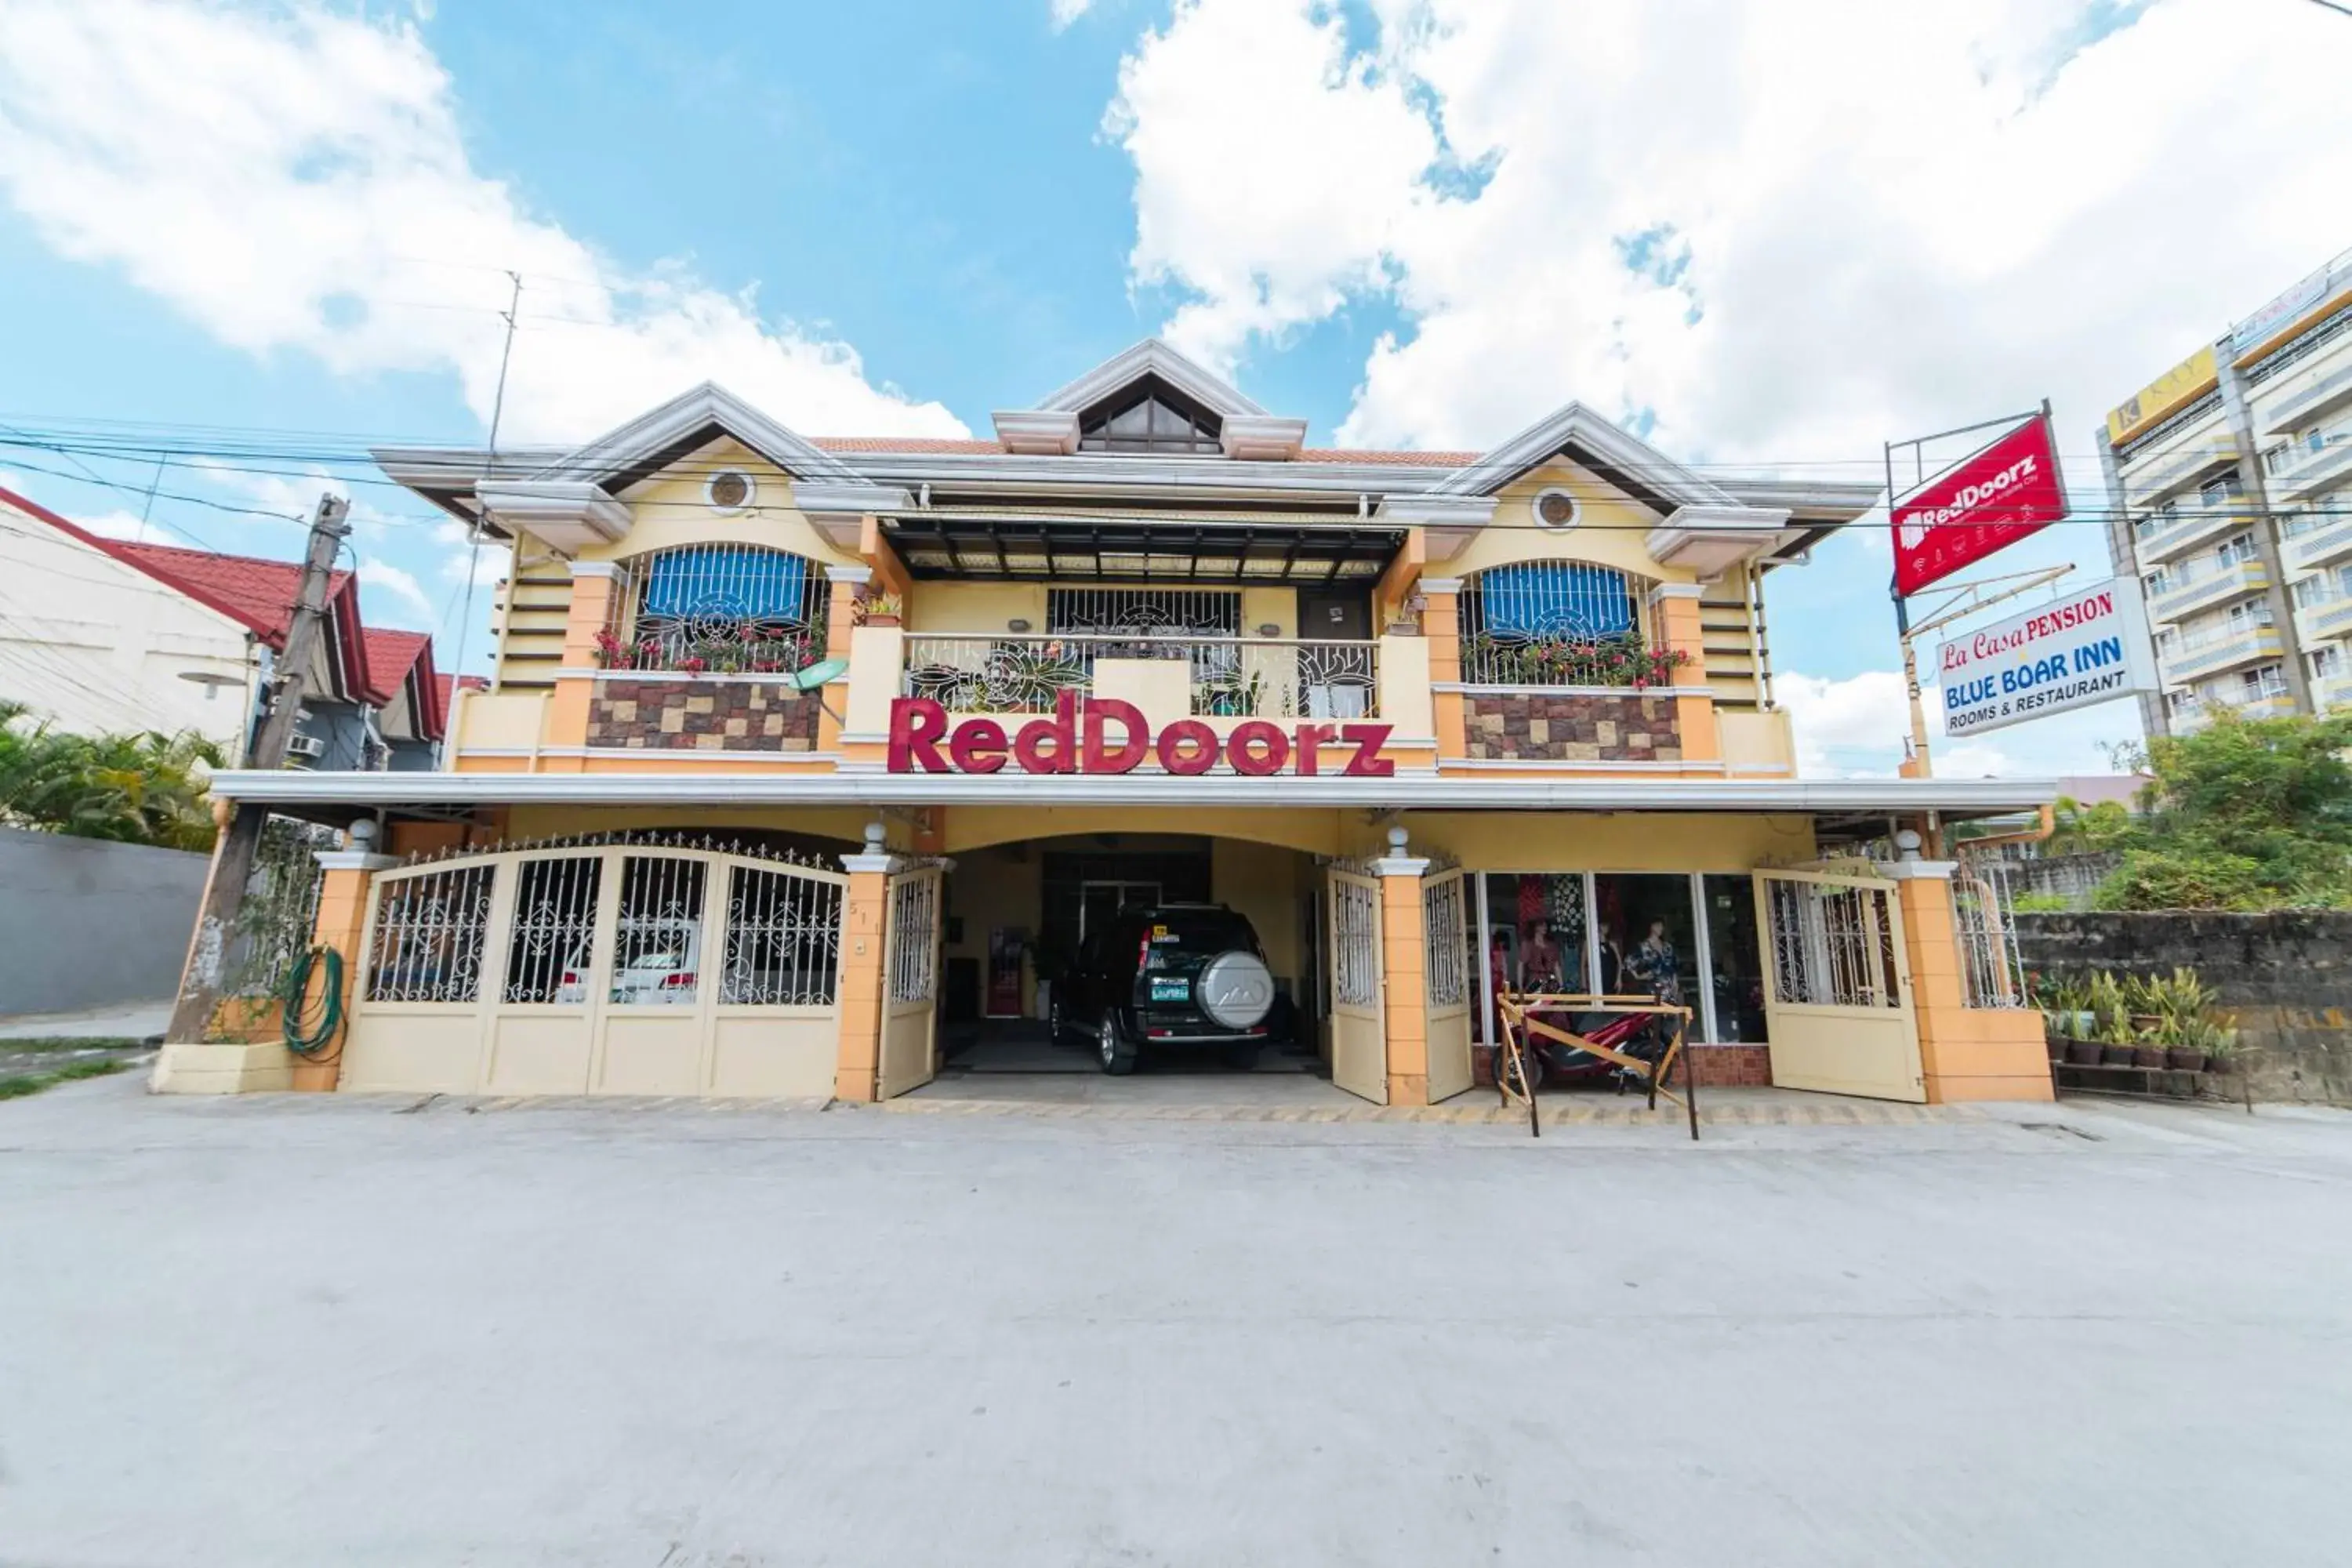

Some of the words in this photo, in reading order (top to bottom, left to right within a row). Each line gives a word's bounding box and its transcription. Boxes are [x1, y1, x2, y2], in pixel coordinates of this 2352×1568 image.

[1922, 454, 2037, 532] RedDoorz
[1943, 644, 1968, 670] La
[1973, 628, 2024, 659] Casa
[2026, 592, 2113, 641] PENSION
[1946, 675, 1997, 709] BLUE
[2002, 654, 2068, 694] BOAR
[2074, 637, 2122, 673] INN
[1950, 706, 1996, 729] ROOMS
[2001, 702, 2011, 716] &
[2016, 671, 2125, 712] RESTAURANT
[887, 687, 1395, 776] RedDoorz
